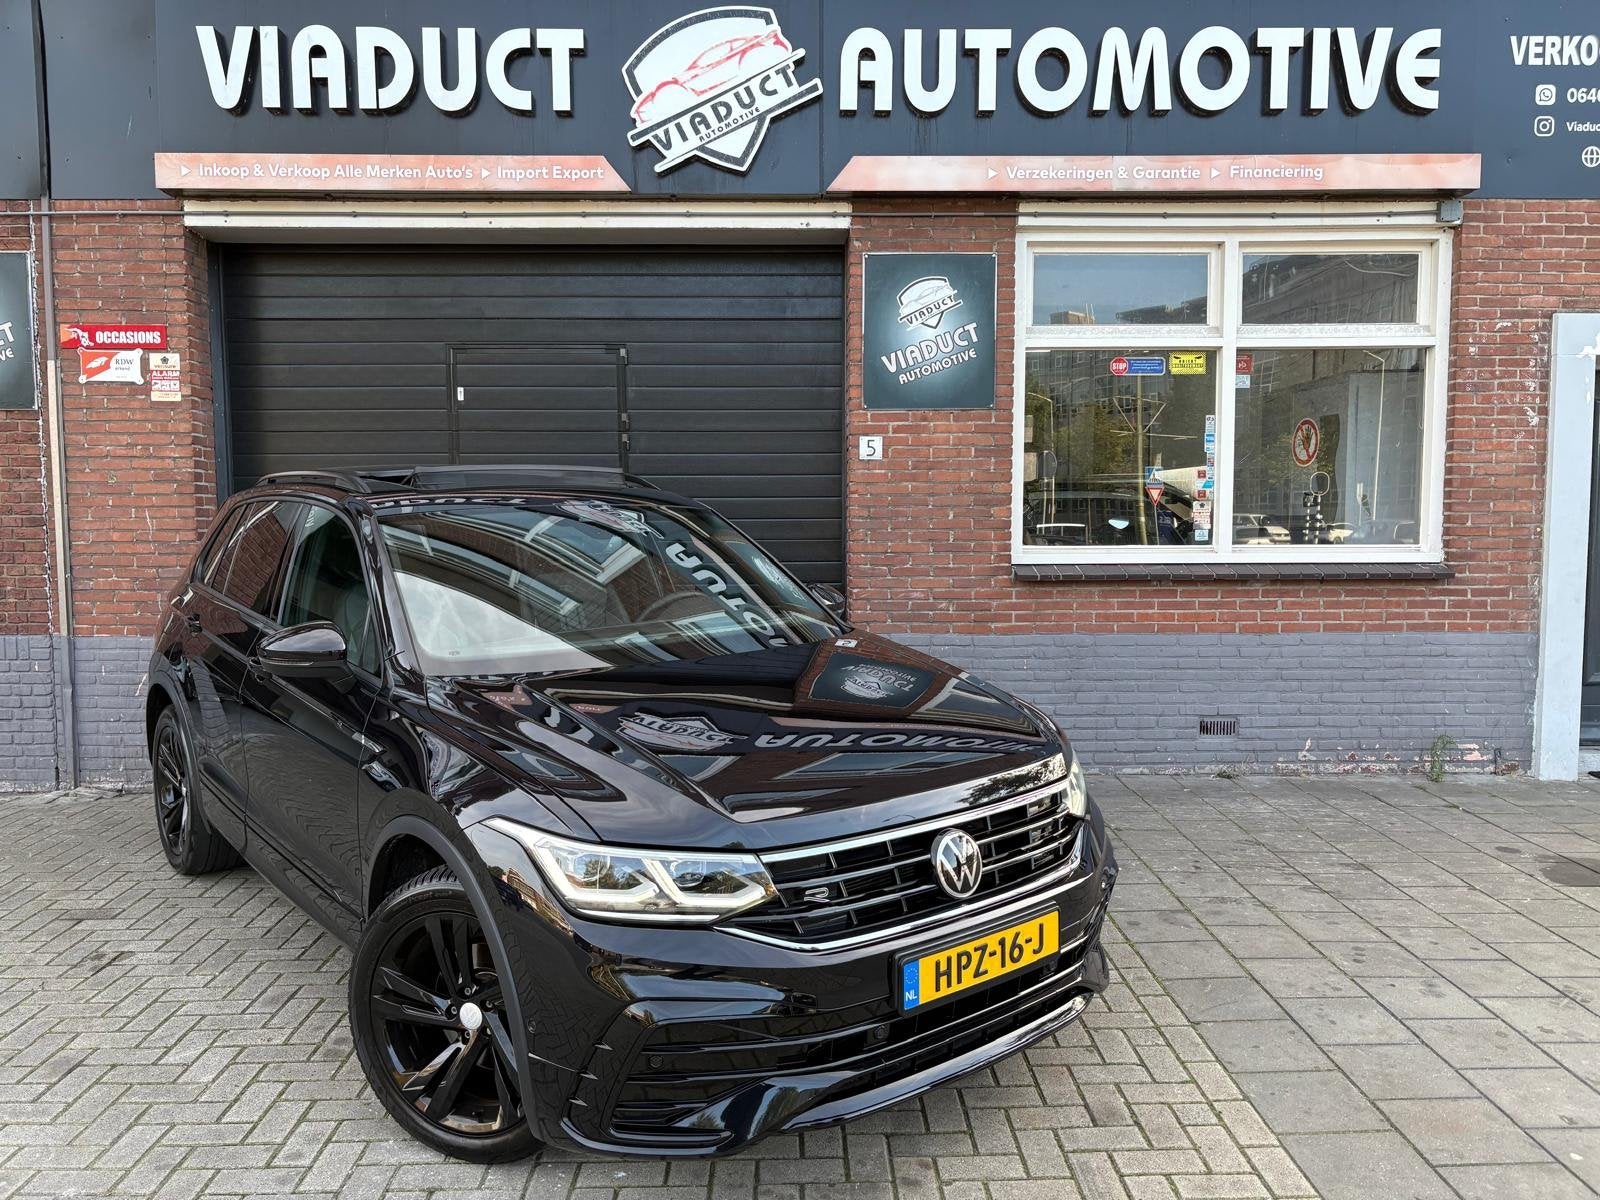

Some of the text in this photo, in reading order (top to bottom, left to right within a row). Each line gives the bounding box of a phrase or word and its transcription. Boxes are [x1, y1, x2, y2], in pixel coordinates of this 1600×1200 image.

[195, 25, 1442, 114] VIADUCT AUTOMOTIVE
[651, 64, 796, 151] VIADUCT
[699, 106, 761, 143] AUTOMOTIVE
[198, 163, 605, 182] Inkoop & Verkoop Alle Merken Auto's Import Export
[1006, 163, 1324, 183] Verzekeringen & Garantie Financiering
[906, 294, 955, 326] VIADUCT
[95, 330, 162, 345] OCCASIONS
[881, 322, 979, 374] VIADUCT
[898, 348, 977, 386] AUTOMOTIVE
[1112, 361, 1127, 370] STOP
[866, 439, 876, 457] 5
[934, 922, 1045, 993] HPZ-16-J
[905, 990, 918, 1002] NL
